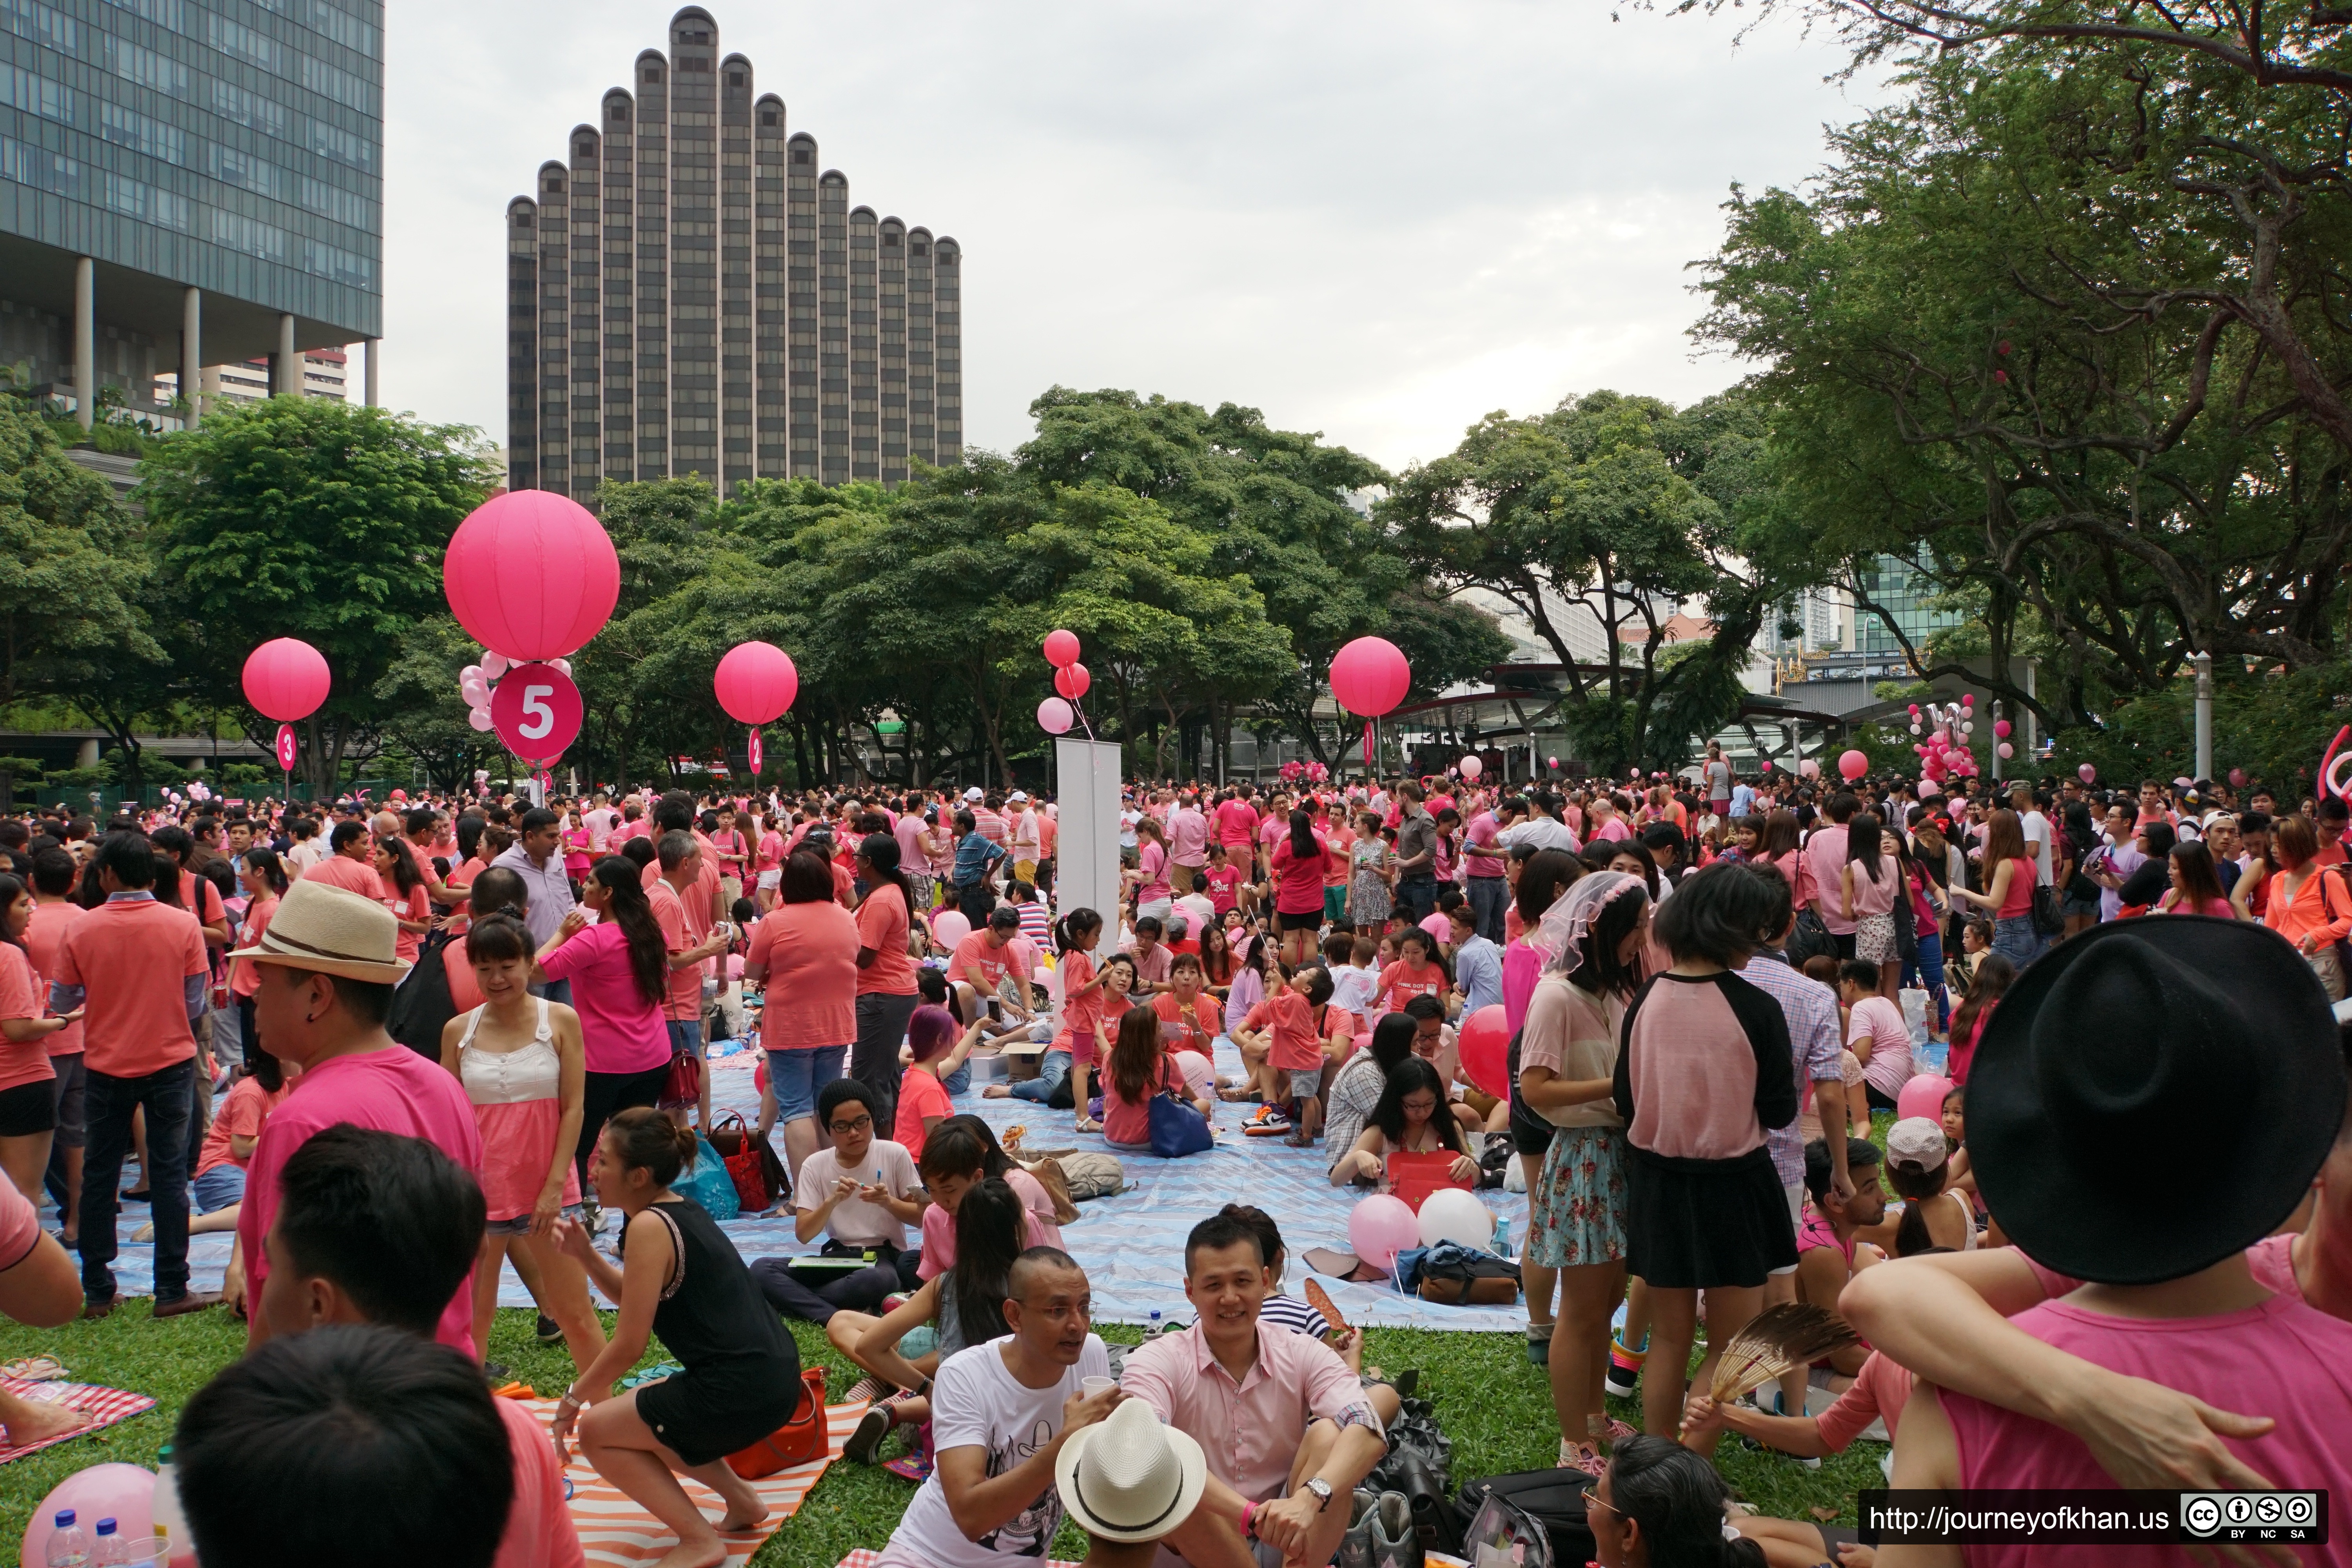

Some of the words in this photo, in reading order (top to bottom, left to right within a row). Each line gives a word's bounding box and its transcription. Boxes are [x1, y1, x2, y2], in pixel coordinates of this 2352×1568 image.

[519, 685, 554, 739] 5
[284, 734, 292, 761] 3
[753, 738, 760, 764] 2
